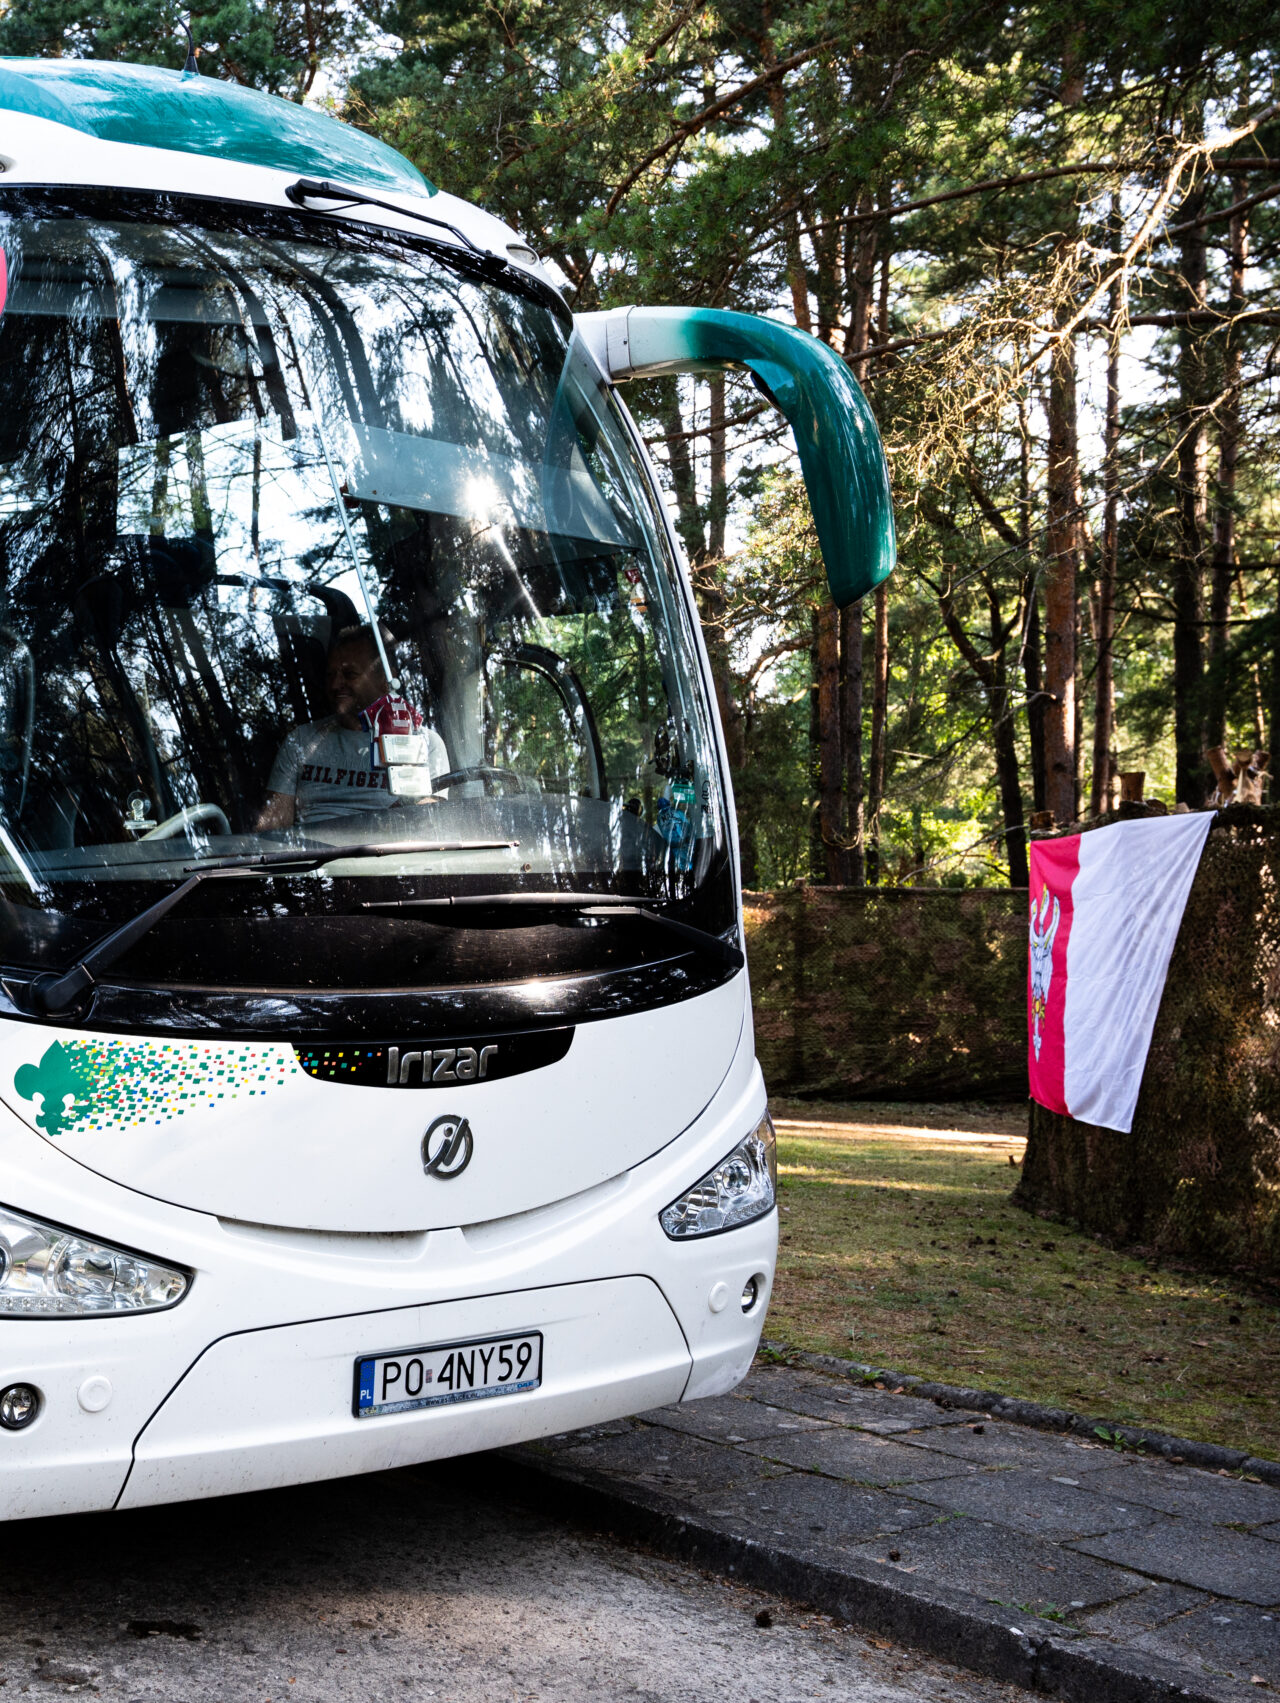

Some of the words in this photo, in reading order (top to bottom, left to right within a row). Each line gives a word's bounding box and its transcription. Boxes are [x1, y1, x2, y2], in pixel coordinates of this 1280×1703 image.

[387, 1044, 498, 1084] Irizar
[381, 1358, 424, 1401] PO
[437, 1341, 532, 1390] 4NY59
[360, 1389, 372, 1401] PL
